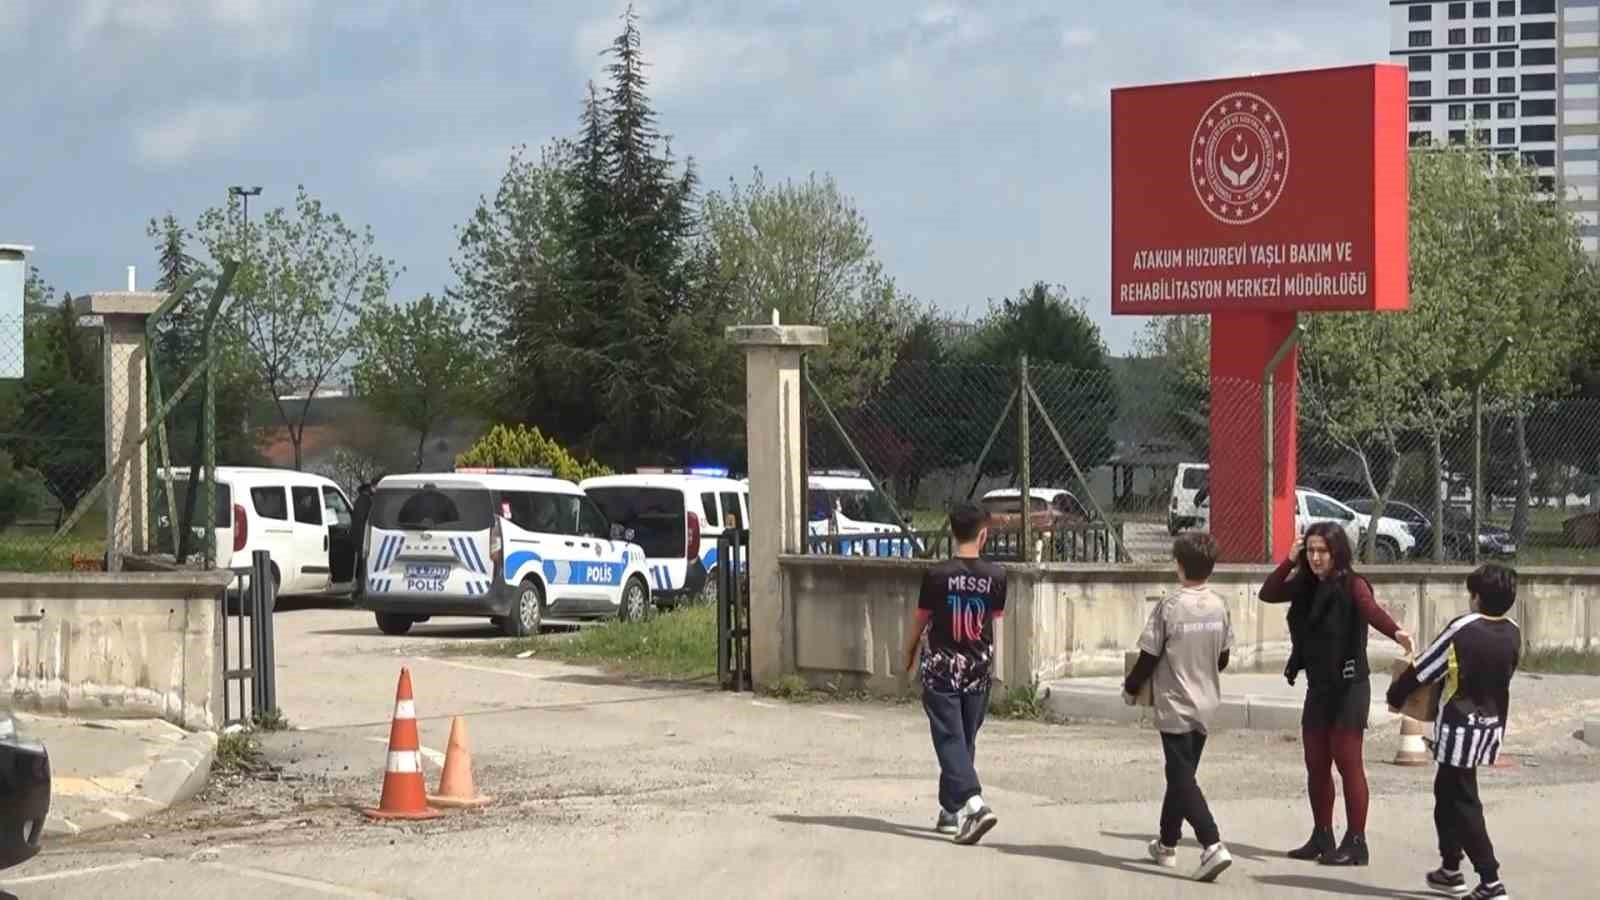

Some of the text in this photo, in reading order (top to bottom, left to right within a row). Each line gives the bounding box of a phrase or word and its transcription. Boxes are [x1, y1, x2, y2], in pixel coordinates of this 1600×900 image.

[1133, 242, 1353, 270] ATAKUM HUZUREVİ YAŞLI BAKIM VE
[1120, 272, 1367, 302] REHABİLİTASYON MERKEZİ MÜDÜRLÜĞÜ
[586, 564, 612, 582] POLİS
[948, 575, 992, 593] MESSI
[946, 594, 986, 643] 10
